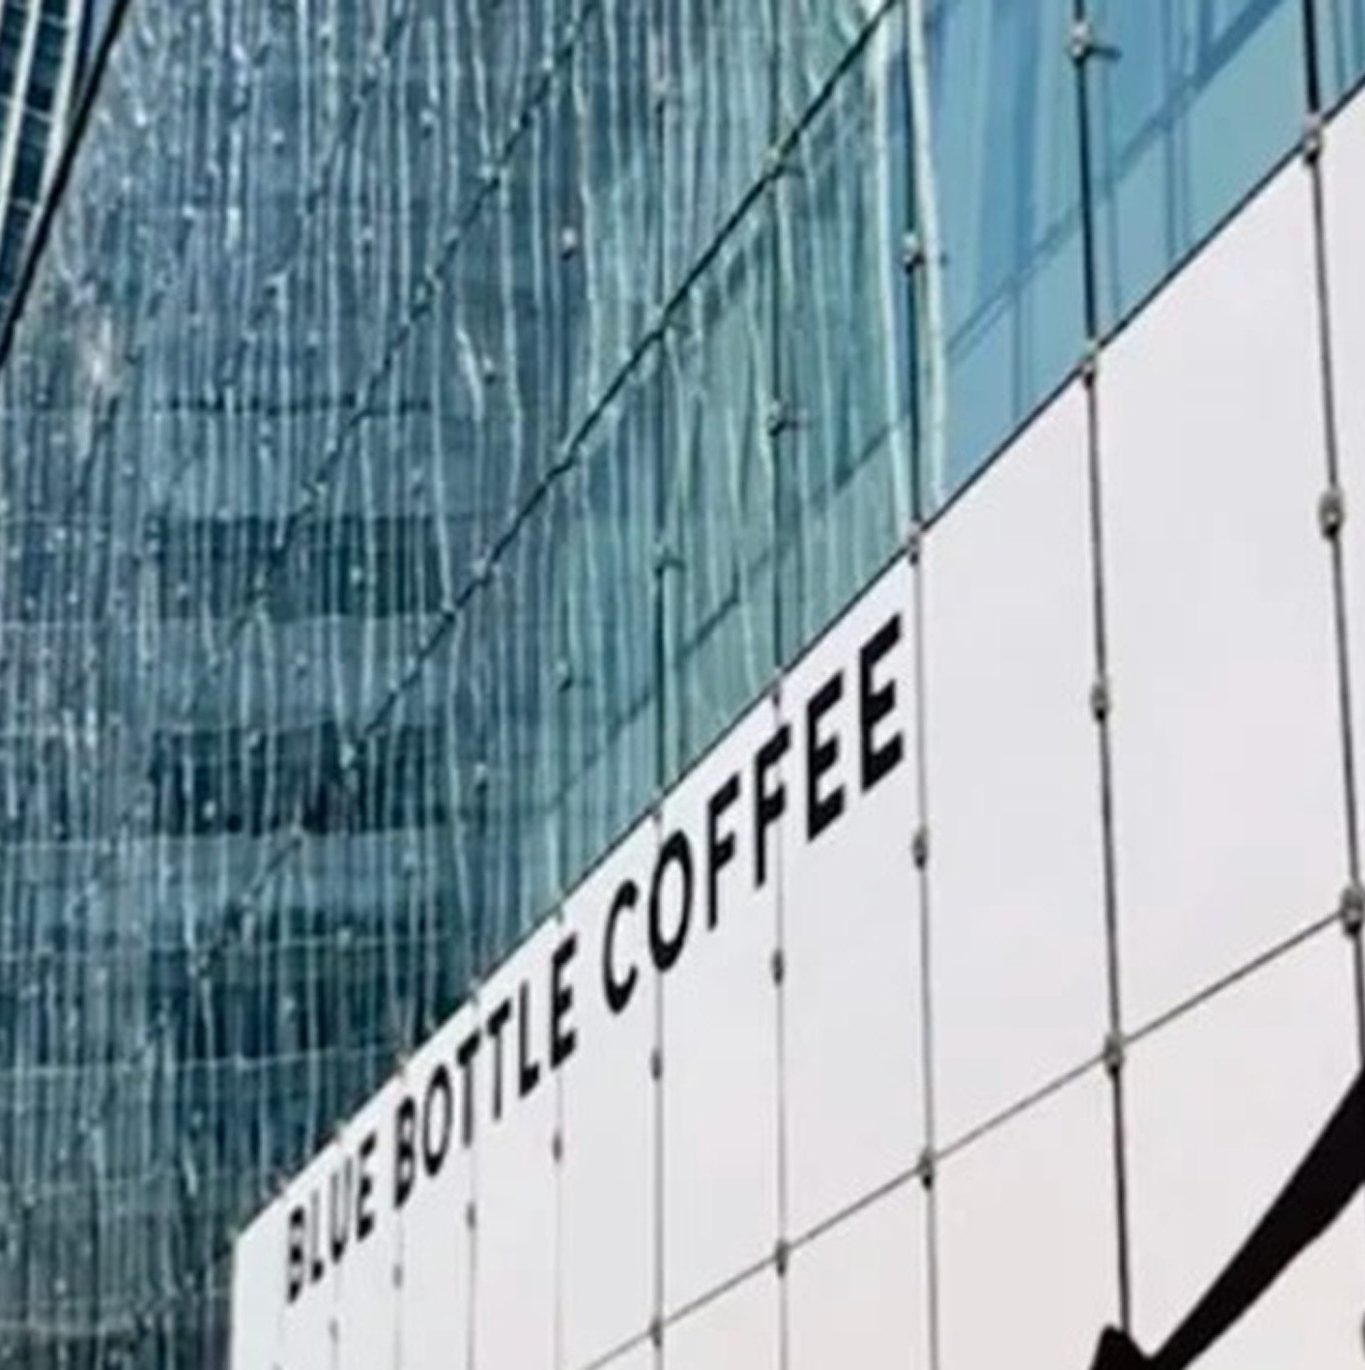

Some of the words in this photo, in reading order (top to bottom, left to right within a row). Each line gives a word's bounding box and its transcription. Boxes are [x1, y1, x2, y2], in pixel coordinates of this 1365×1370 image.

[286, 1132, 376, 1304] BLUE
[394, 933, 577, 1210] BOTTLE
[602, 612, 904, 1014] COFFEE
